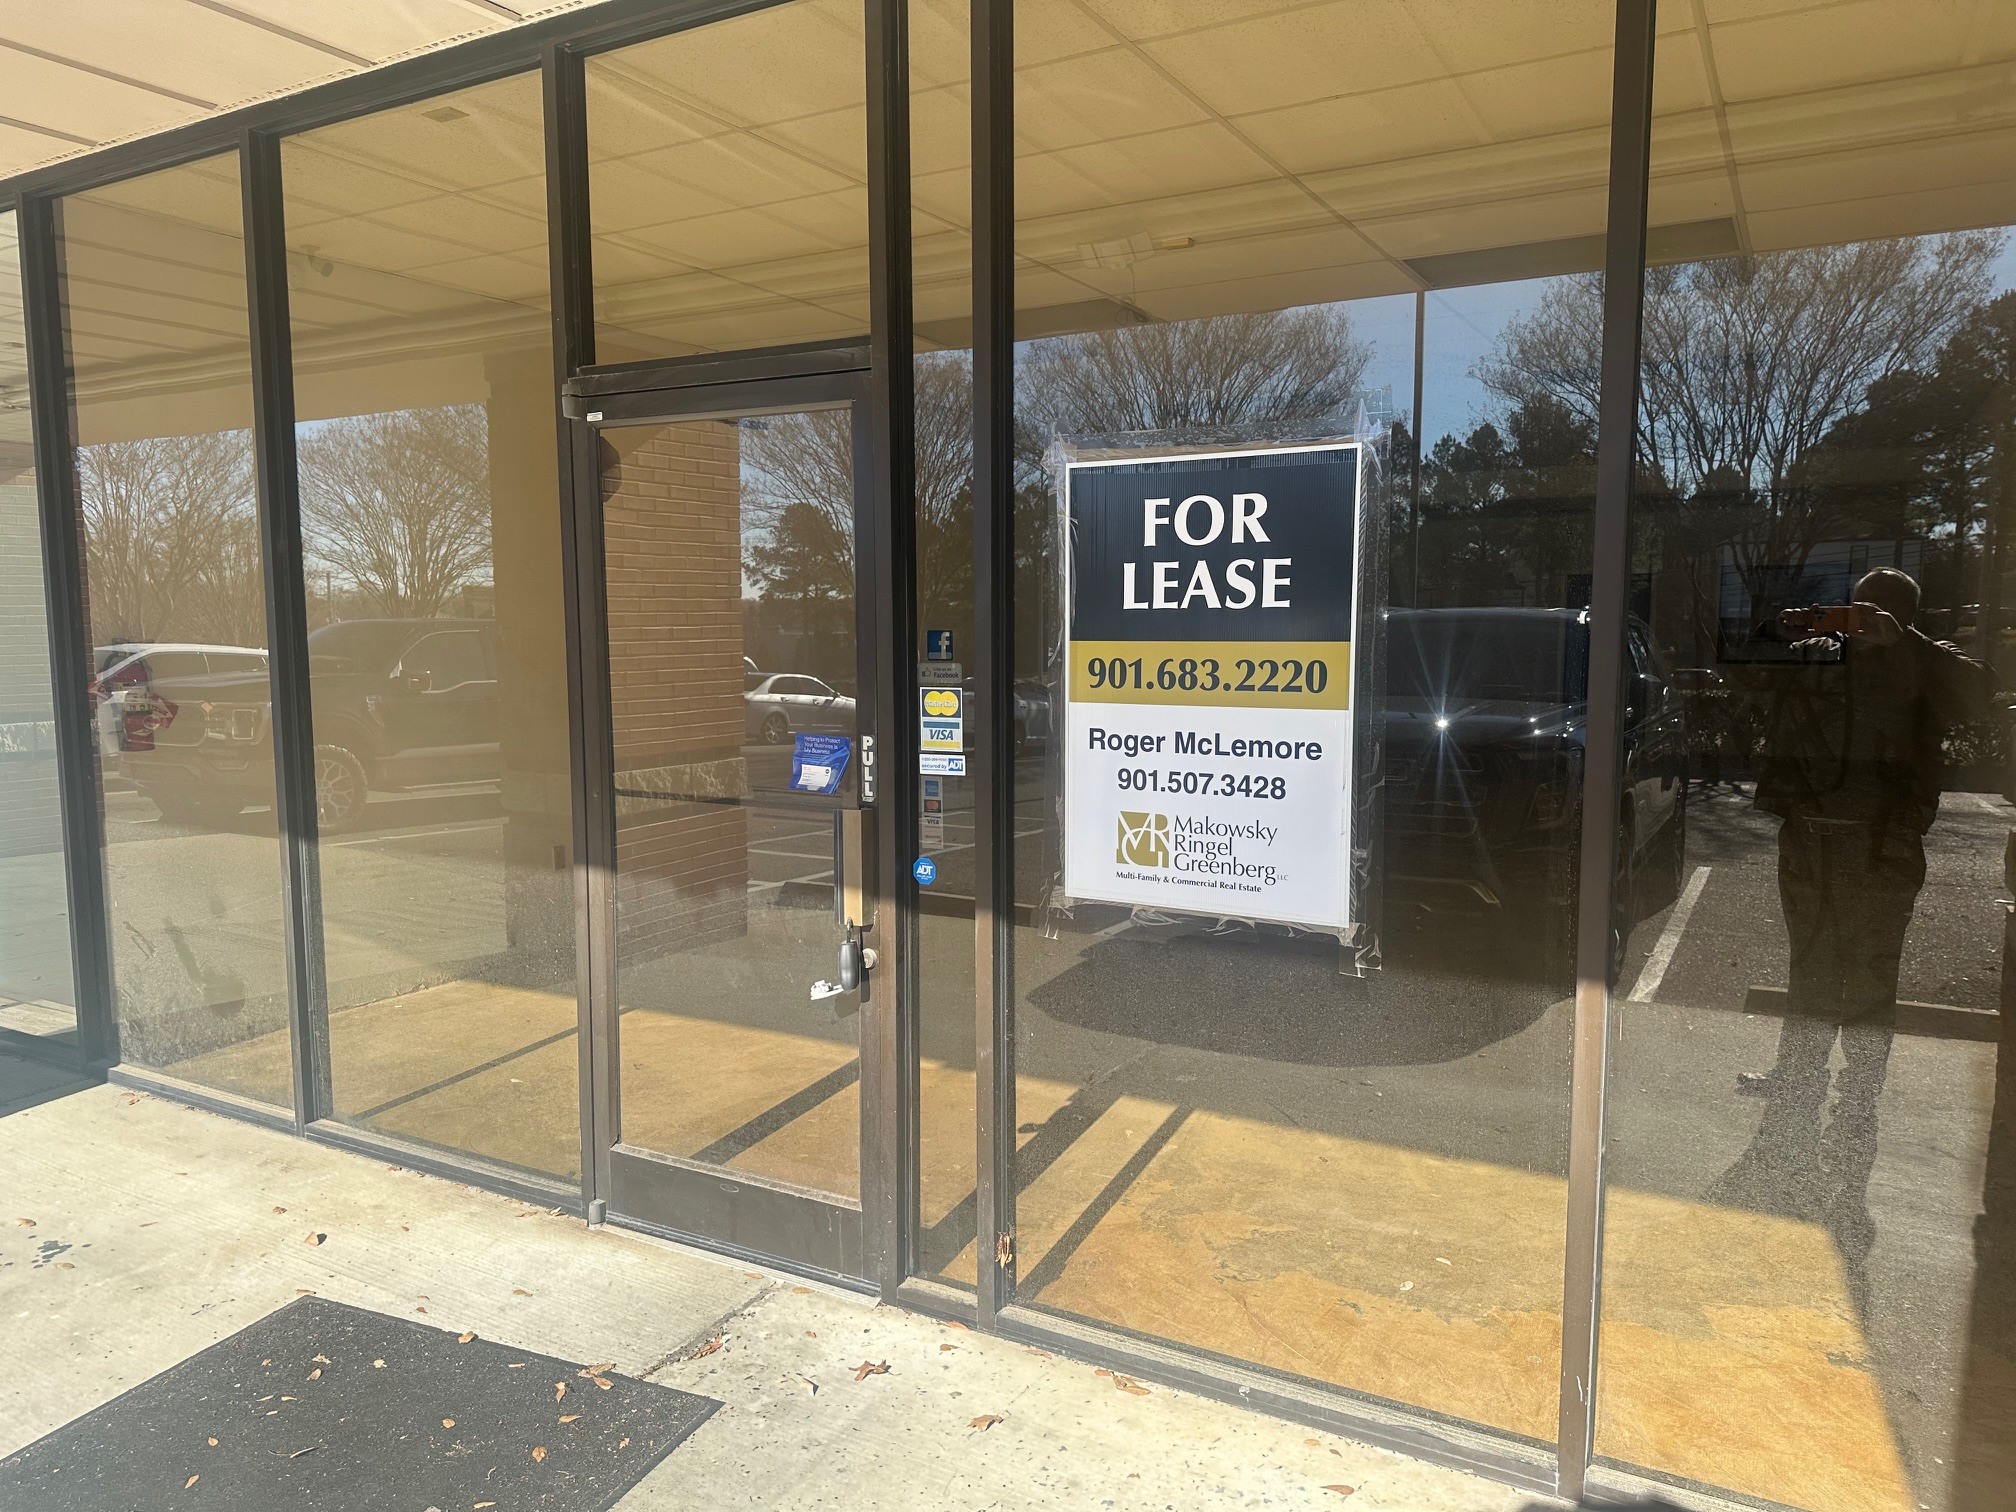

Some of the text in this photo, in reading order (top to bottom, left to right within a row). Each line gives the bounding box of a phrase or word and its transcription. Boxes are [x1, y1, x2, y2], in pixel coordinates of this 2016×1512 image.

[1144, 493, 1271, 546] FOR
[1122, 558, 1291, 609] LEASE
[1088, 657, 1328, 694] 901.683.2220
[929, 729, 954, 740] VISA
[1089, 727, 1323, 761] Roger McLemore
[862, 735, 874, 797] PULL
[948, 760, 963, 770] ADT
[1117, 768, 1287, 800] 901.507.3428
[926, 818, 940, 826] VISA
[1174, 815, 1278, 846] Makowsky
[1174, 834, 1232, 861] Ringel
[916, 865, 934, 876] ADT
[1116, 871, 1262, 893] Multi-Family & Commercial Real Estate
[1174, 852, 1276, 886] Greenberg
